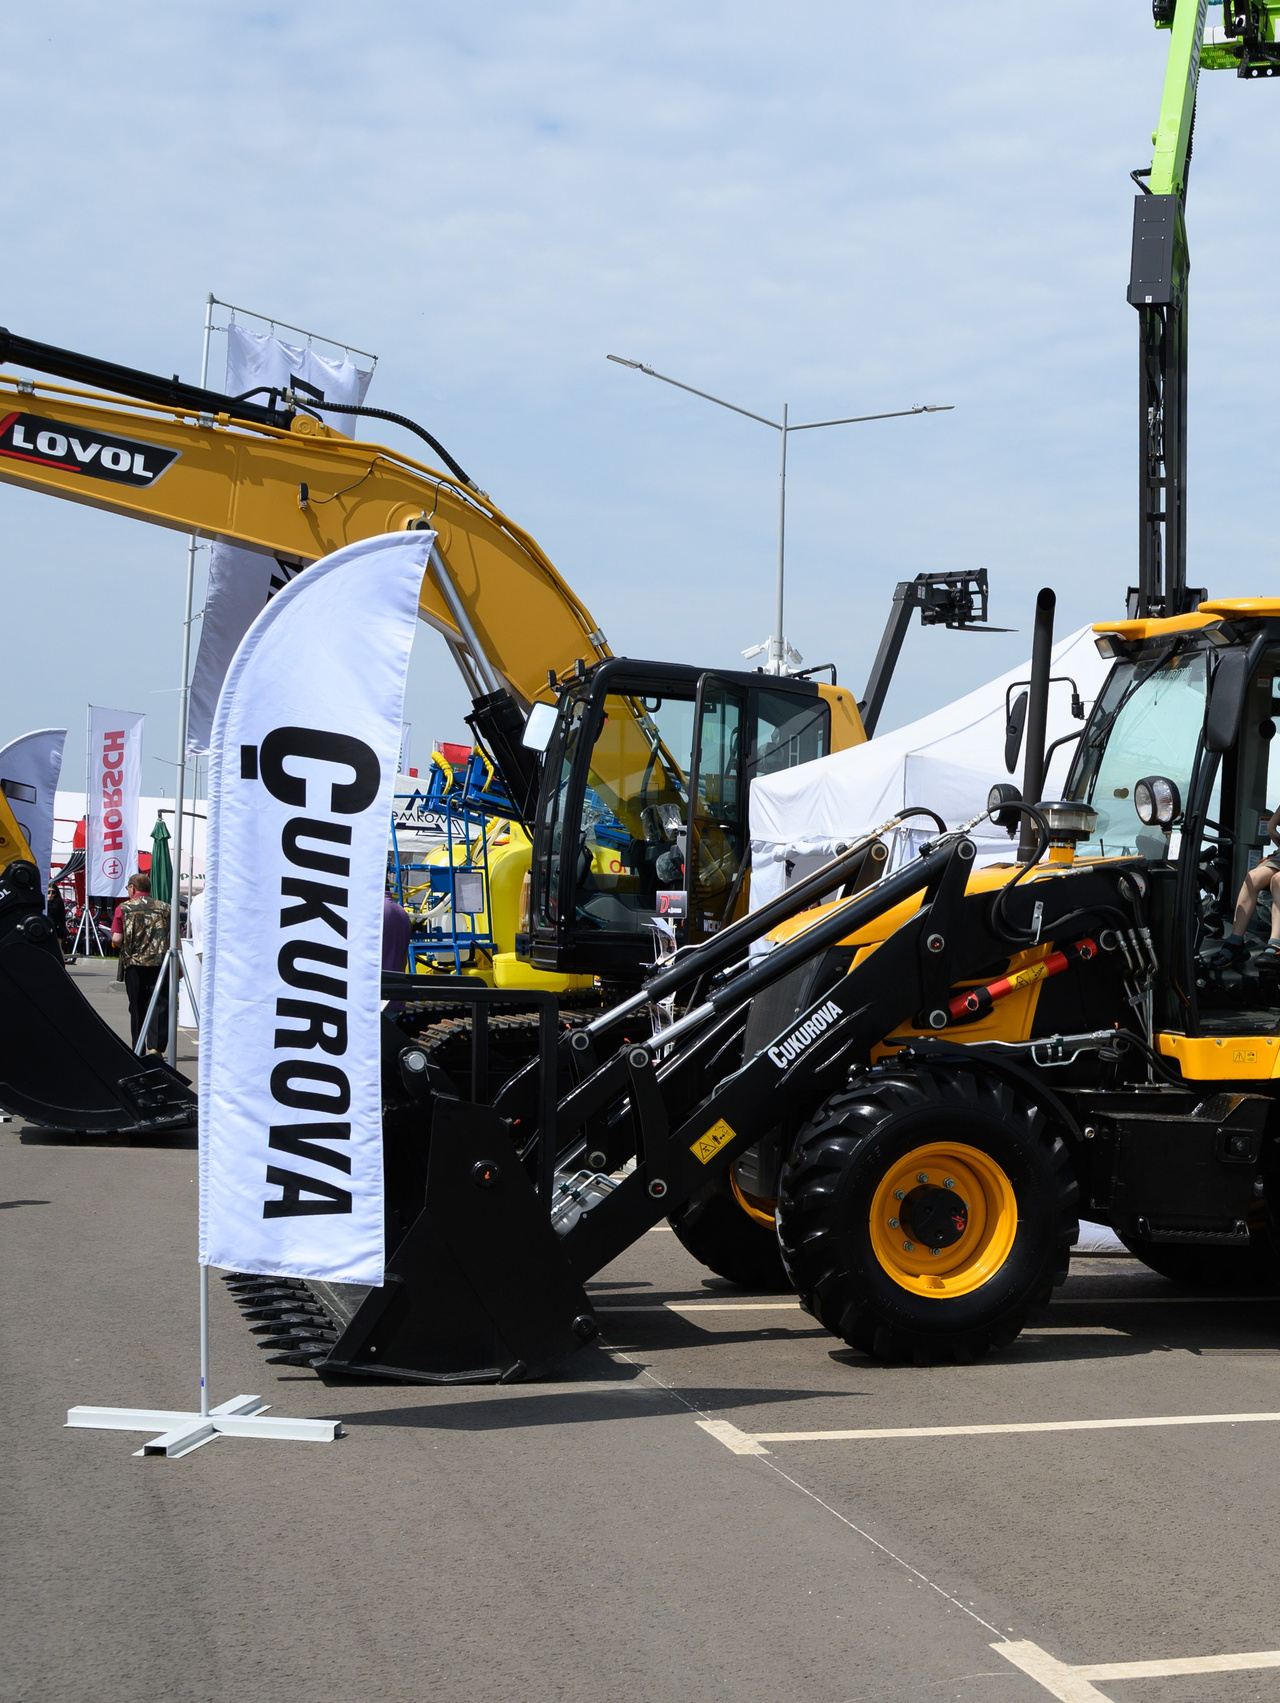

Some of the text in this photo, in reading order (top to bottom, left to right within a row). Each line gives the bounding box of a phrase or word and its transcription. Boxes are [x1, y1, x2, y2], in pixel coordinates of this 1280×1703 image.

[12, 424, 154, 478] LOVOL
[240, 725, 382, 1219] ÇUKUROVA
[767, 1000, 843, 1070] ÇUKUROVA
